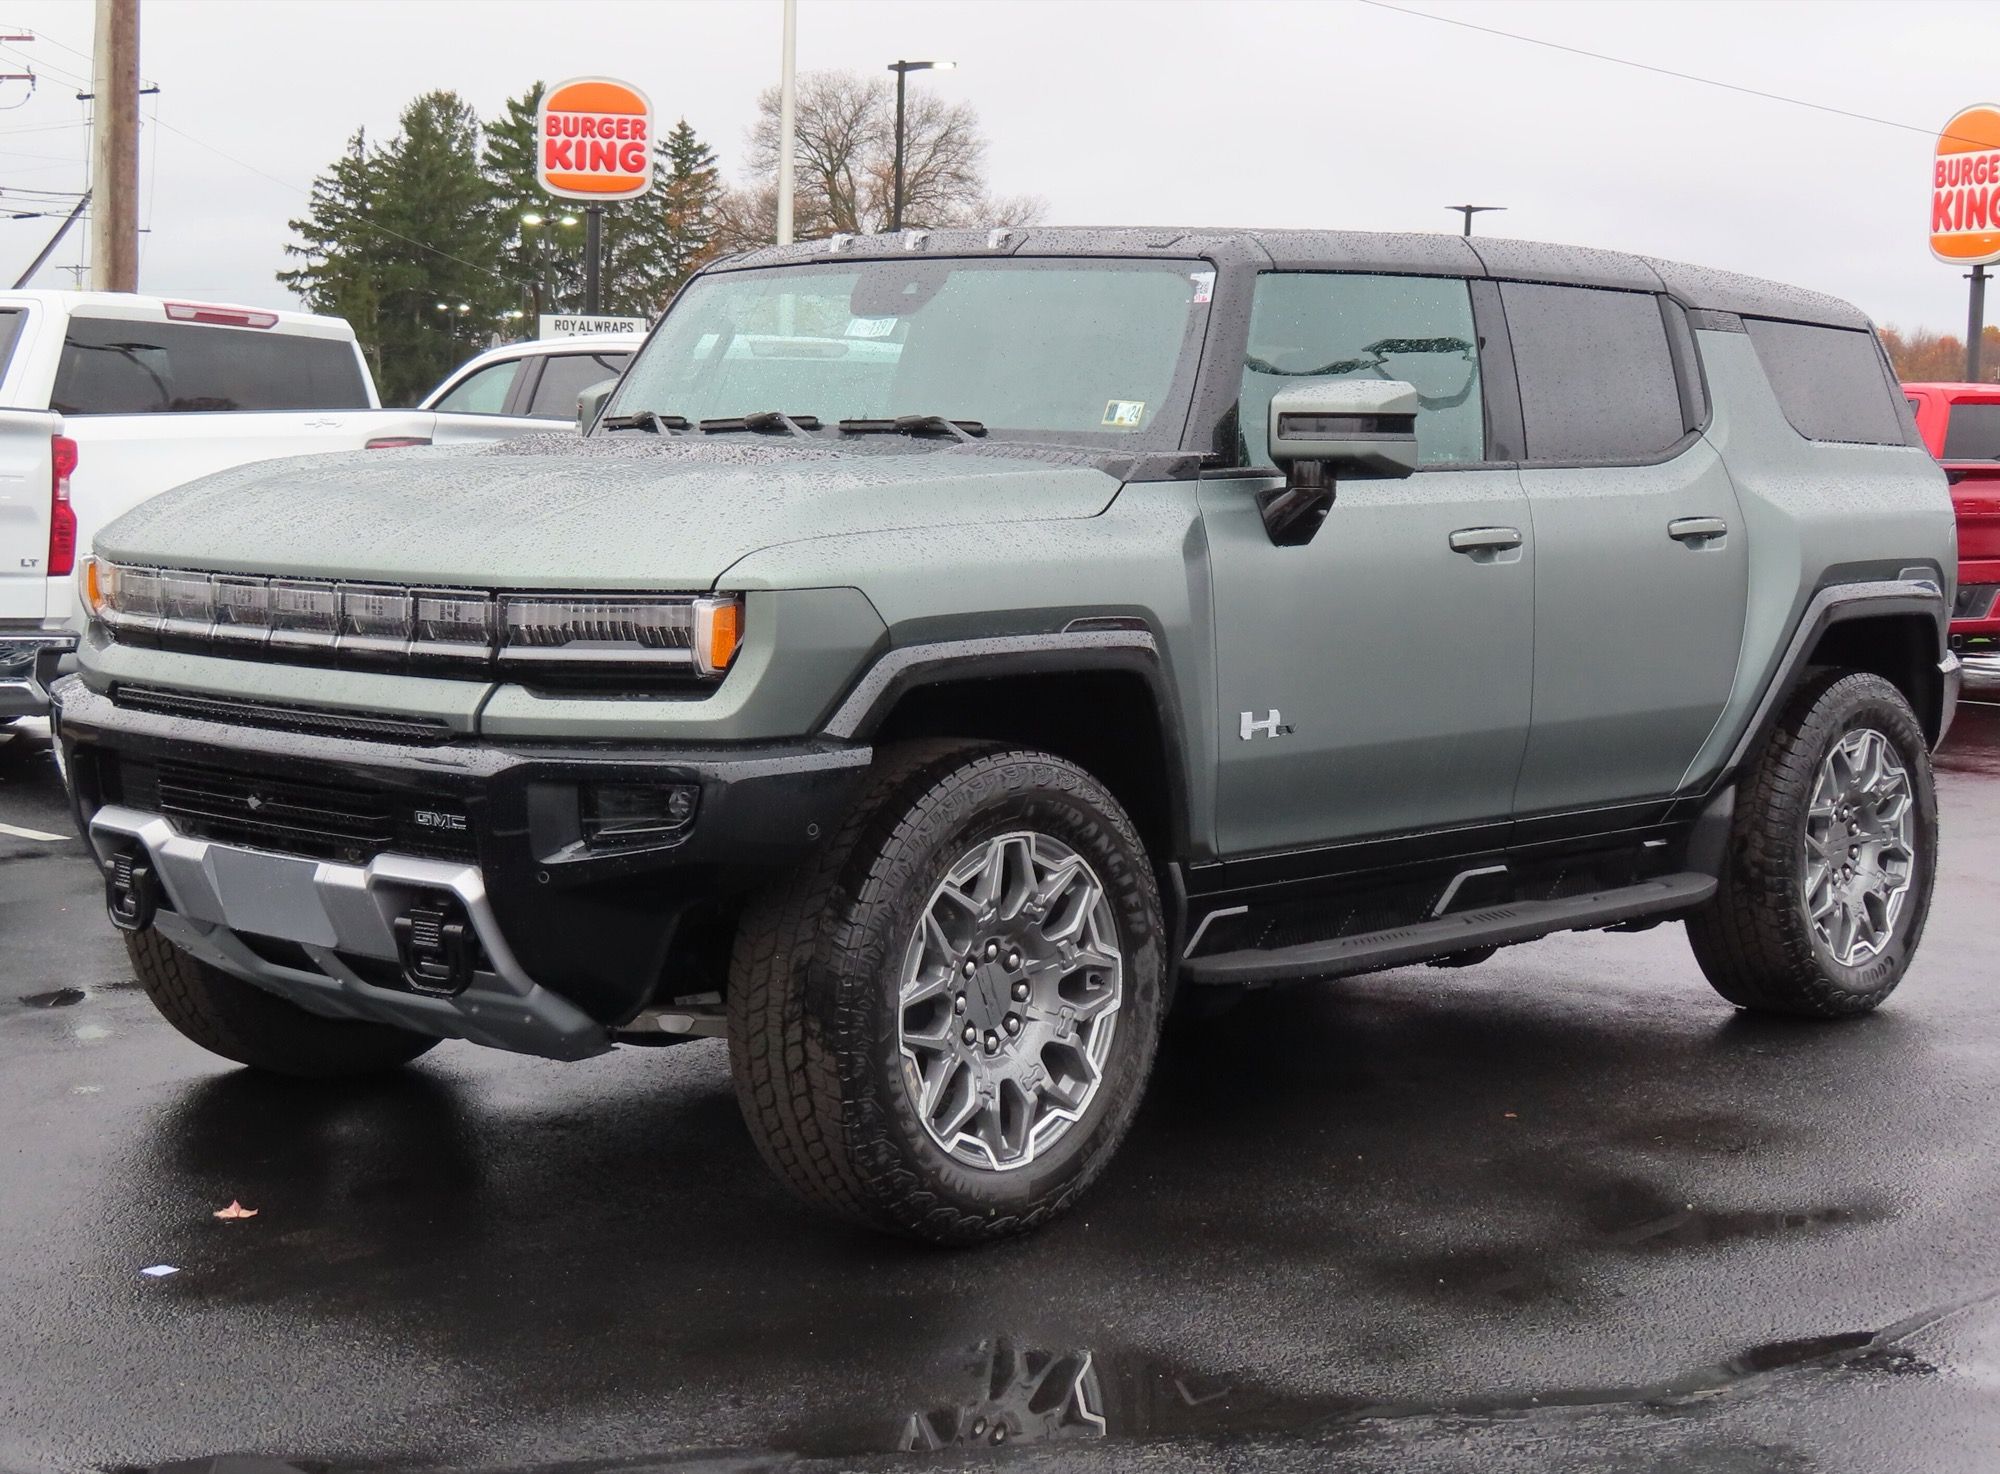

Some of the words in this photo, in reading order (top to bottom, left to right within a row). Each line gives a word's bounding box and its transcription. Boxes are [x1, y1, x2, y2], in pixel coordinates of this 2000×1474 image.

[546, 114, 647, 141] BURGER
[546, 138, 647, 173] KING
[1935, 153, 2000, 189] BURGE
[20, 558, 39, 567] LT
[415, 810, 467, 830] GMC
